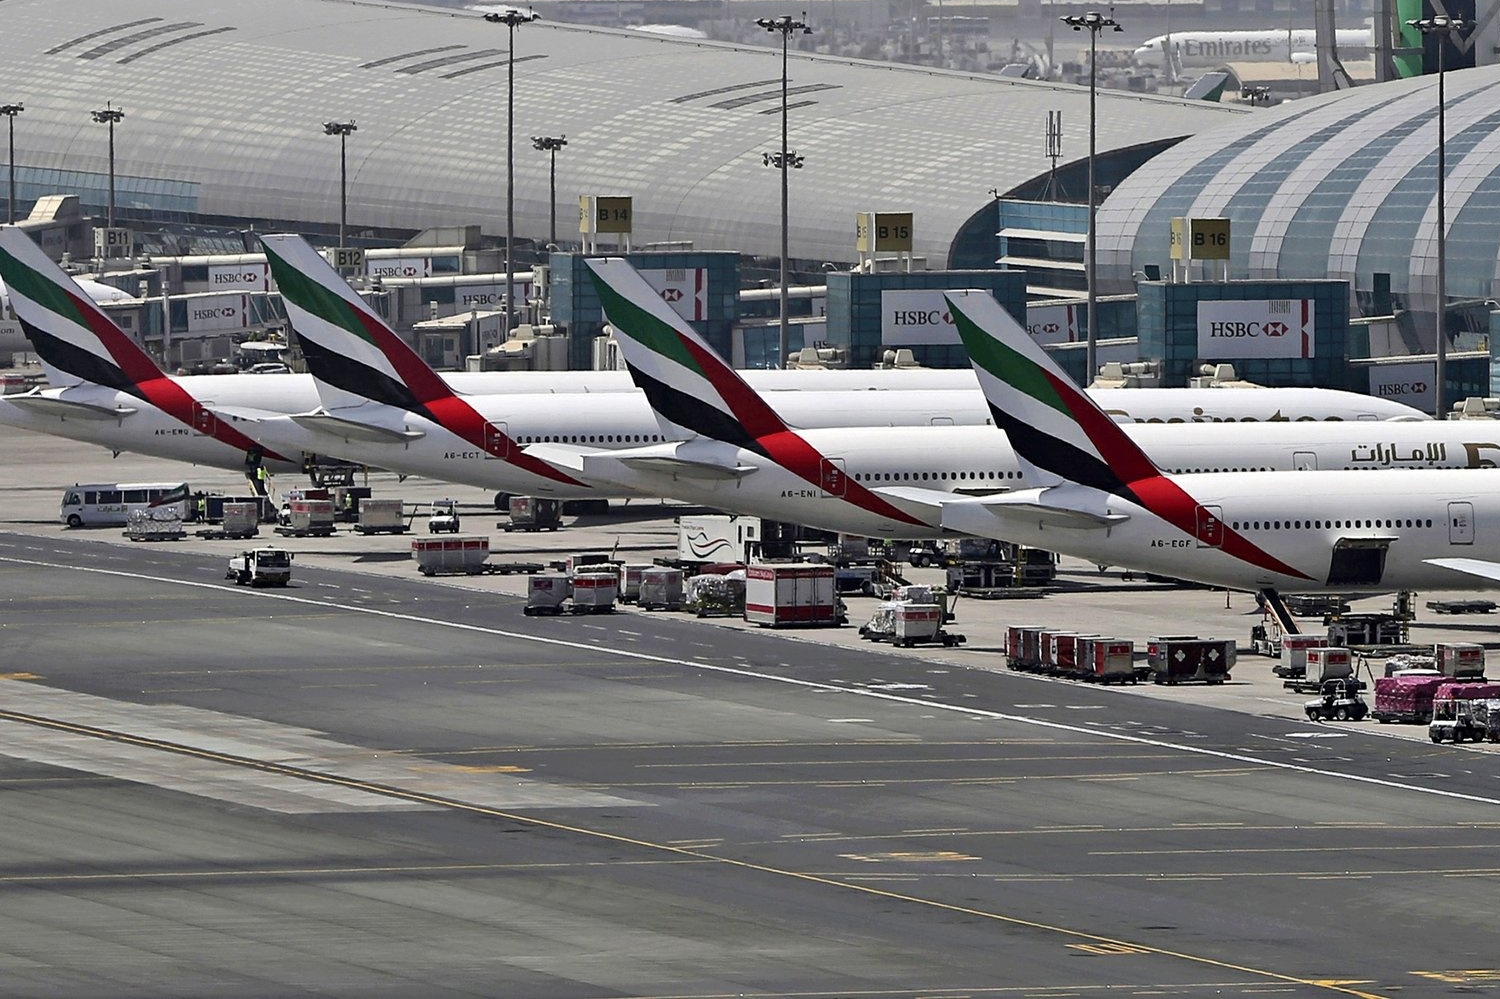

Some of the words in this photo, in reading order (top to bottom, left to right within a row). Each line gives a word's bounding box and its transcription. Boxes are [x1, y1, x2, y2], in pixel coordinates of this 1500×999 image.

[1184, 38, 1272, 57] Emirates
[600, 209, 608, 220] B
[613, 209, 627, 220] 14
[108, 232, 128, 244] B11
[879, 226, 888, 238] B
[893, 226, 908, 238] 15
[1194, 232, 1204, 245] B
[1209, 232, 1226, 245] 16
[338, 252, 361, 265] B12
[374, 267, 401, 277] HSBC
[215, 274, 242, 283] HSBC
[463, 294, 497, 305] HSBC
[194, 308, 220, 320] HSBC
[894, 311, 940, 325] HSBC
[1026, 324, 1041, 335] BC
[1210, 322, 1260, 337] HSBC
[1378, 383, 1410, 395] HSBC
[1351, 442, 1447, 466] الإمارات
[1151, 540, 1191, 548] A6-EGF
